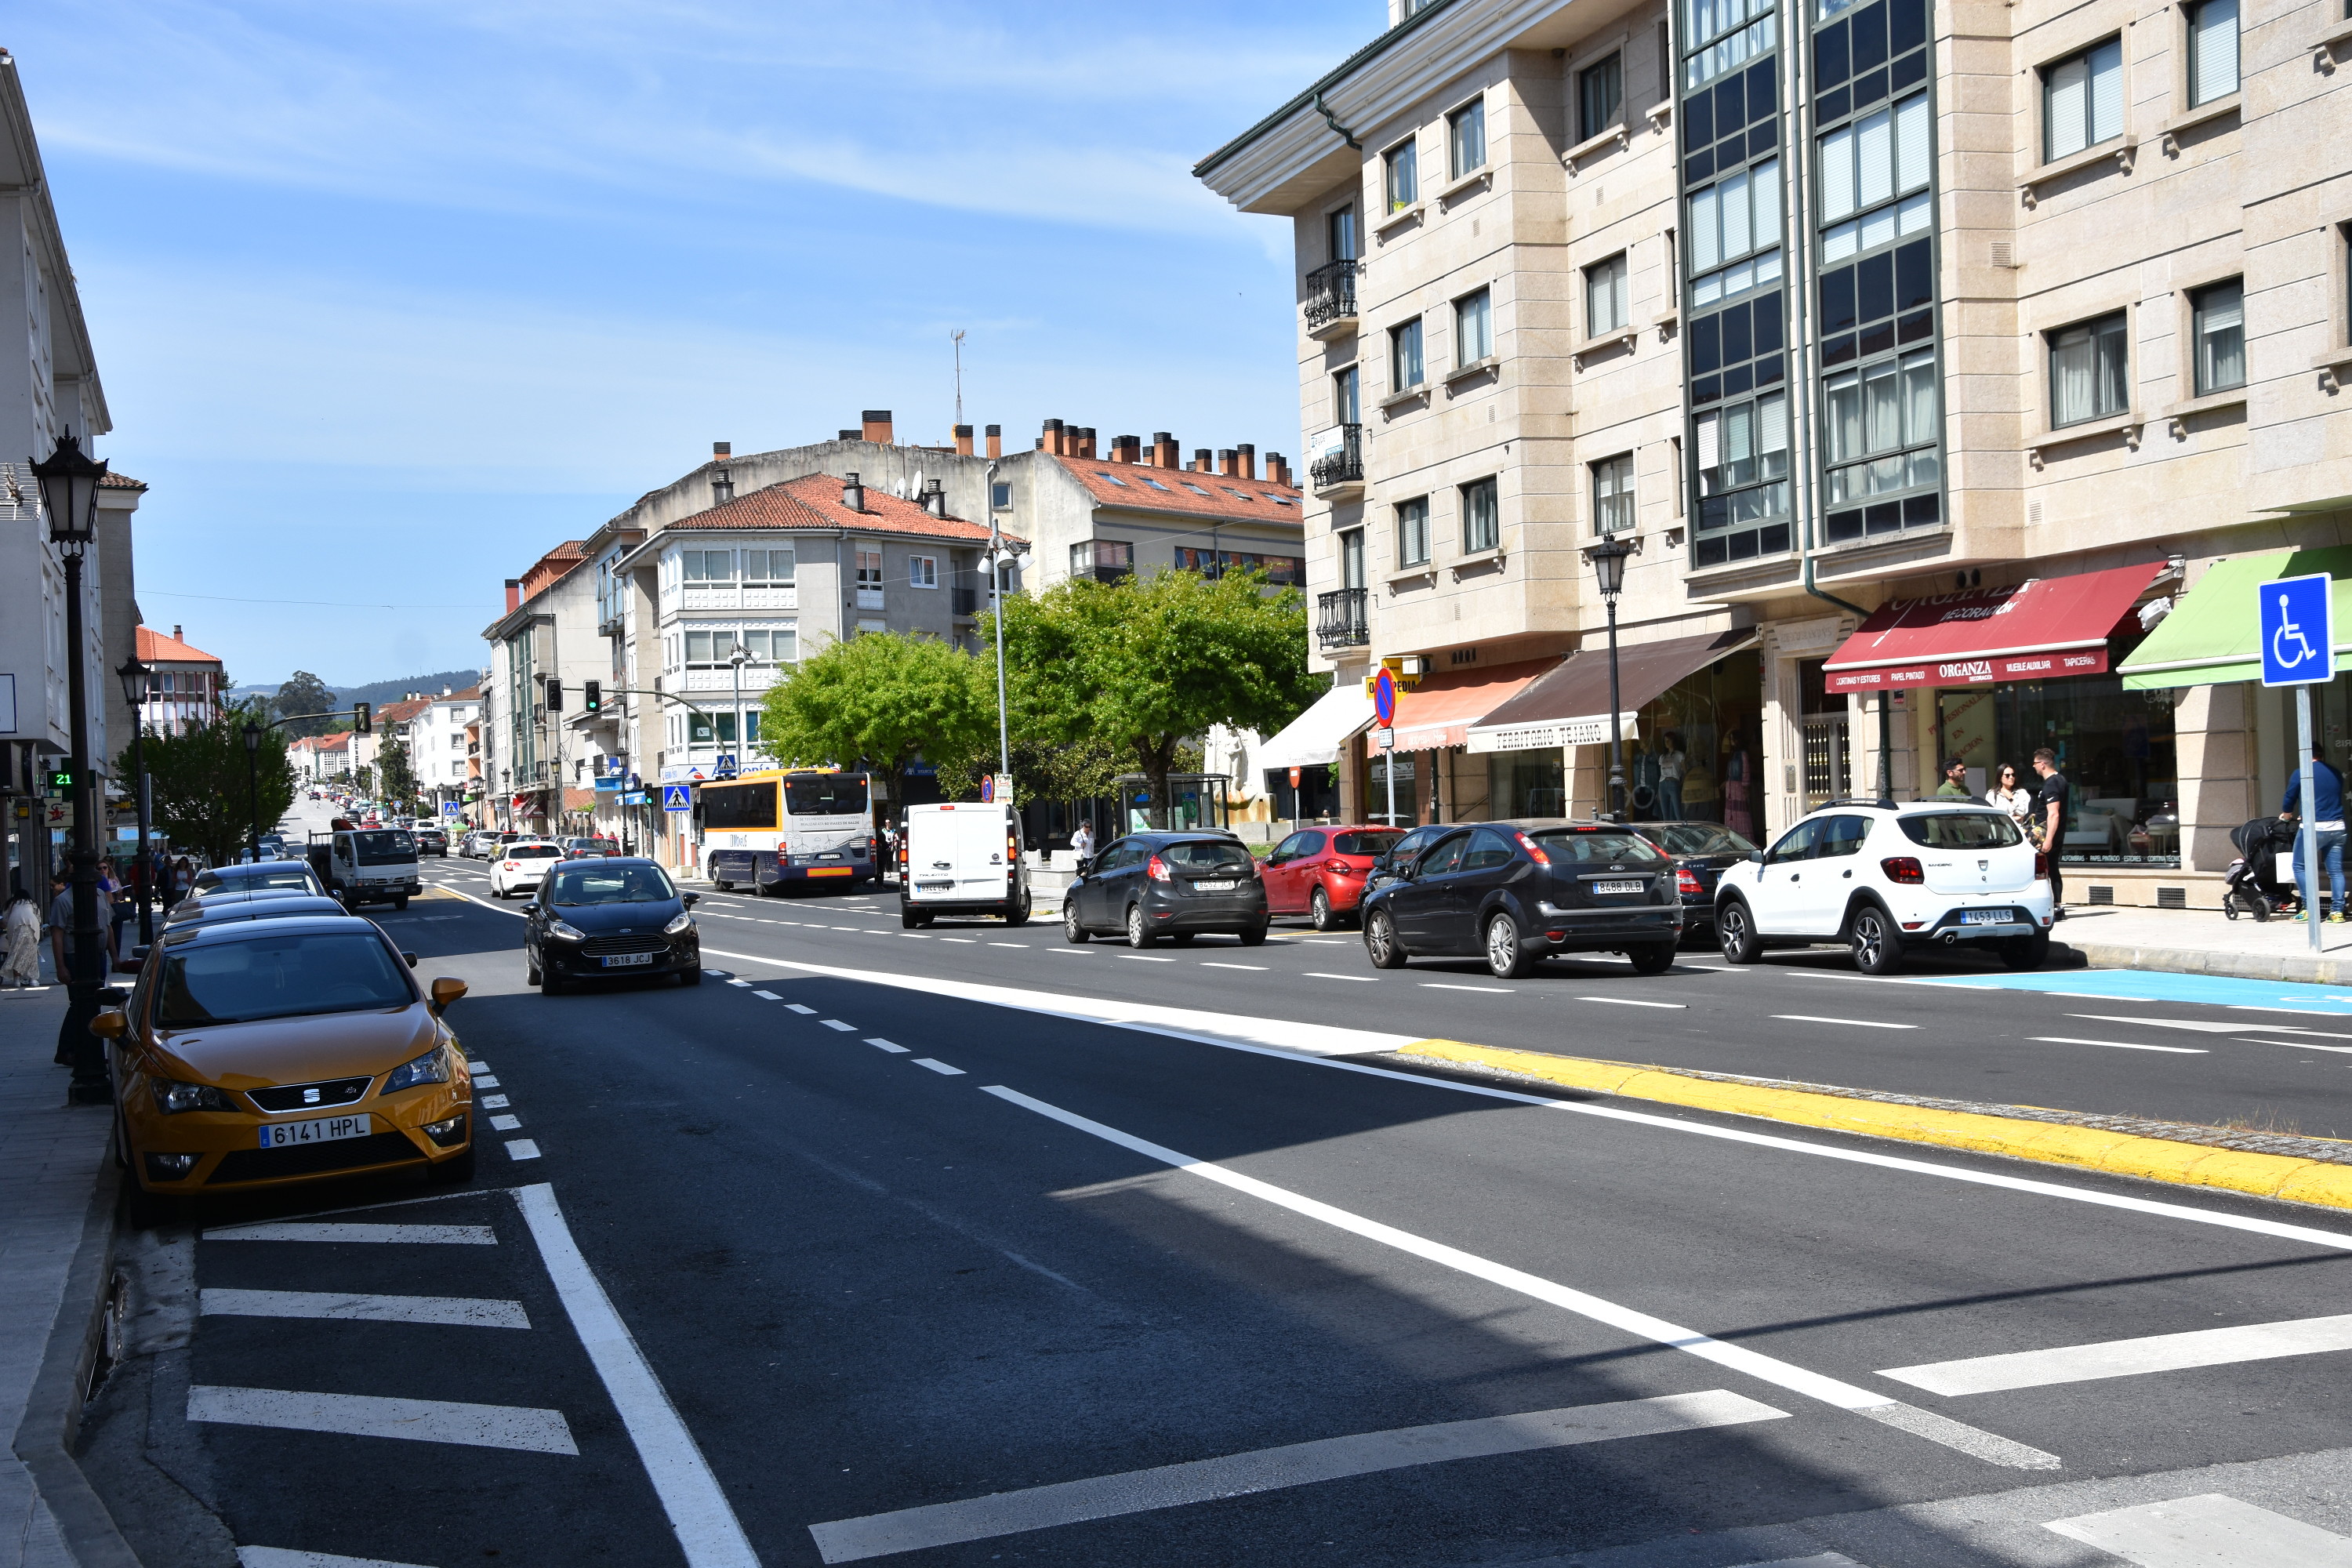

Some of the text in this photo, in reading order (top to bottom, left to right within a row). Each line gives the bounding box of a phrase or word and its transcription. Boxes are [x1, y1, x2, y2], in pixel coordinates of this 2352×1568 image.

[1940, 600, 2018, 622] DECORACIÓN
[1939, 661, 1992, 677] ORGANZA
[2006, 660, 2051, 672] MUEBLE AUXILIAR
[1836, 676, 1857, 685] CORTINAS
[1860, 674, 1881, 684] ESTORES
[1891, 671, 1925, 681] PAPEL PINTADO
[1497, 724, 1601, 749] TERRITORIO TEJANO
[1951, 727, 1965, 739] EN
[56, 774, 72, 784] 21
[1599, 881, 1641, 892] 8488 DLB
[1969, 910, 2011, 921] 1453 LLS
[608, 954, 650, 965] 3618 JCJ
[274, 1117, 365, 1144] 6141 HPL
